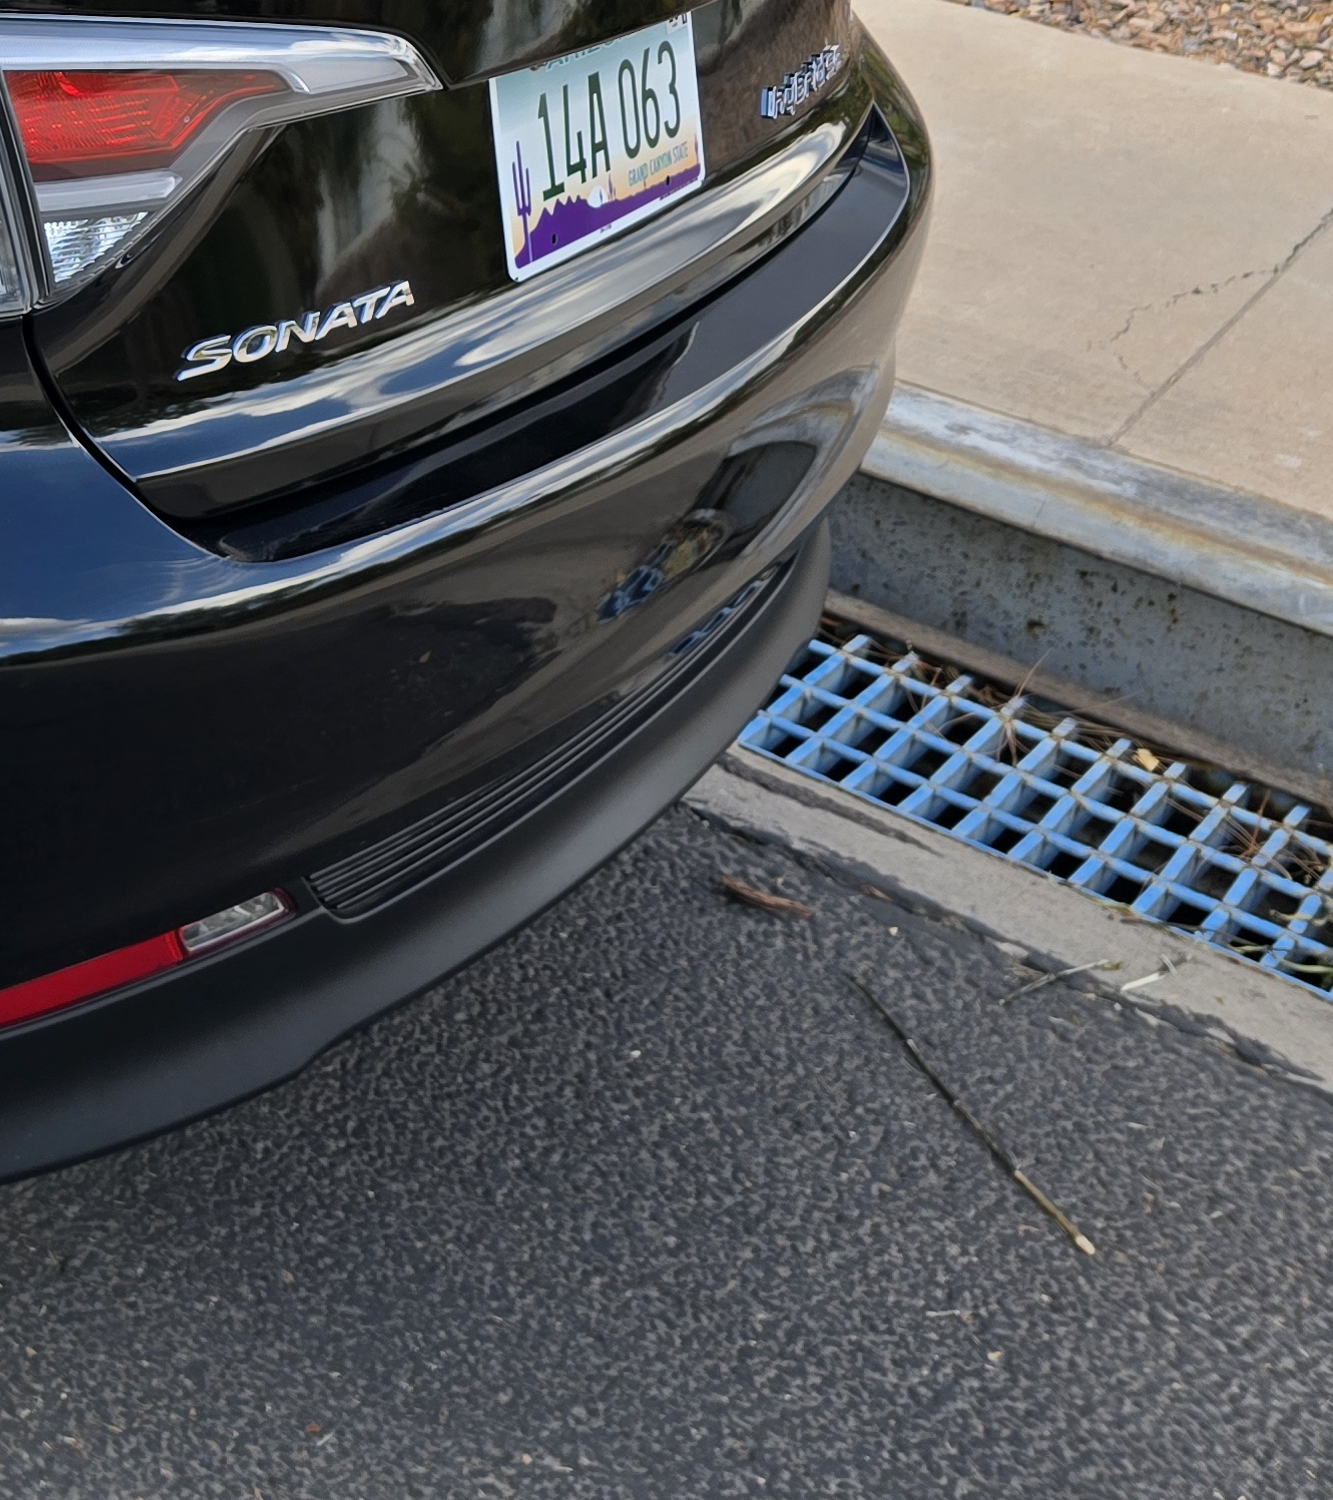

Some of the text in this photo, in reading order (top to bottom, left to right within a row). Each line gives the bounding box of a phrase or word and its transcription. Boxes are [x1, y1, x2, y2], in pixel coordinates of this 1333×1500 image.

[537, 40, 681, 202] 14A 063
[628, 141, 689, 187] GRAND CANYON STATE
[174, 279, 415, 382] SONATA
